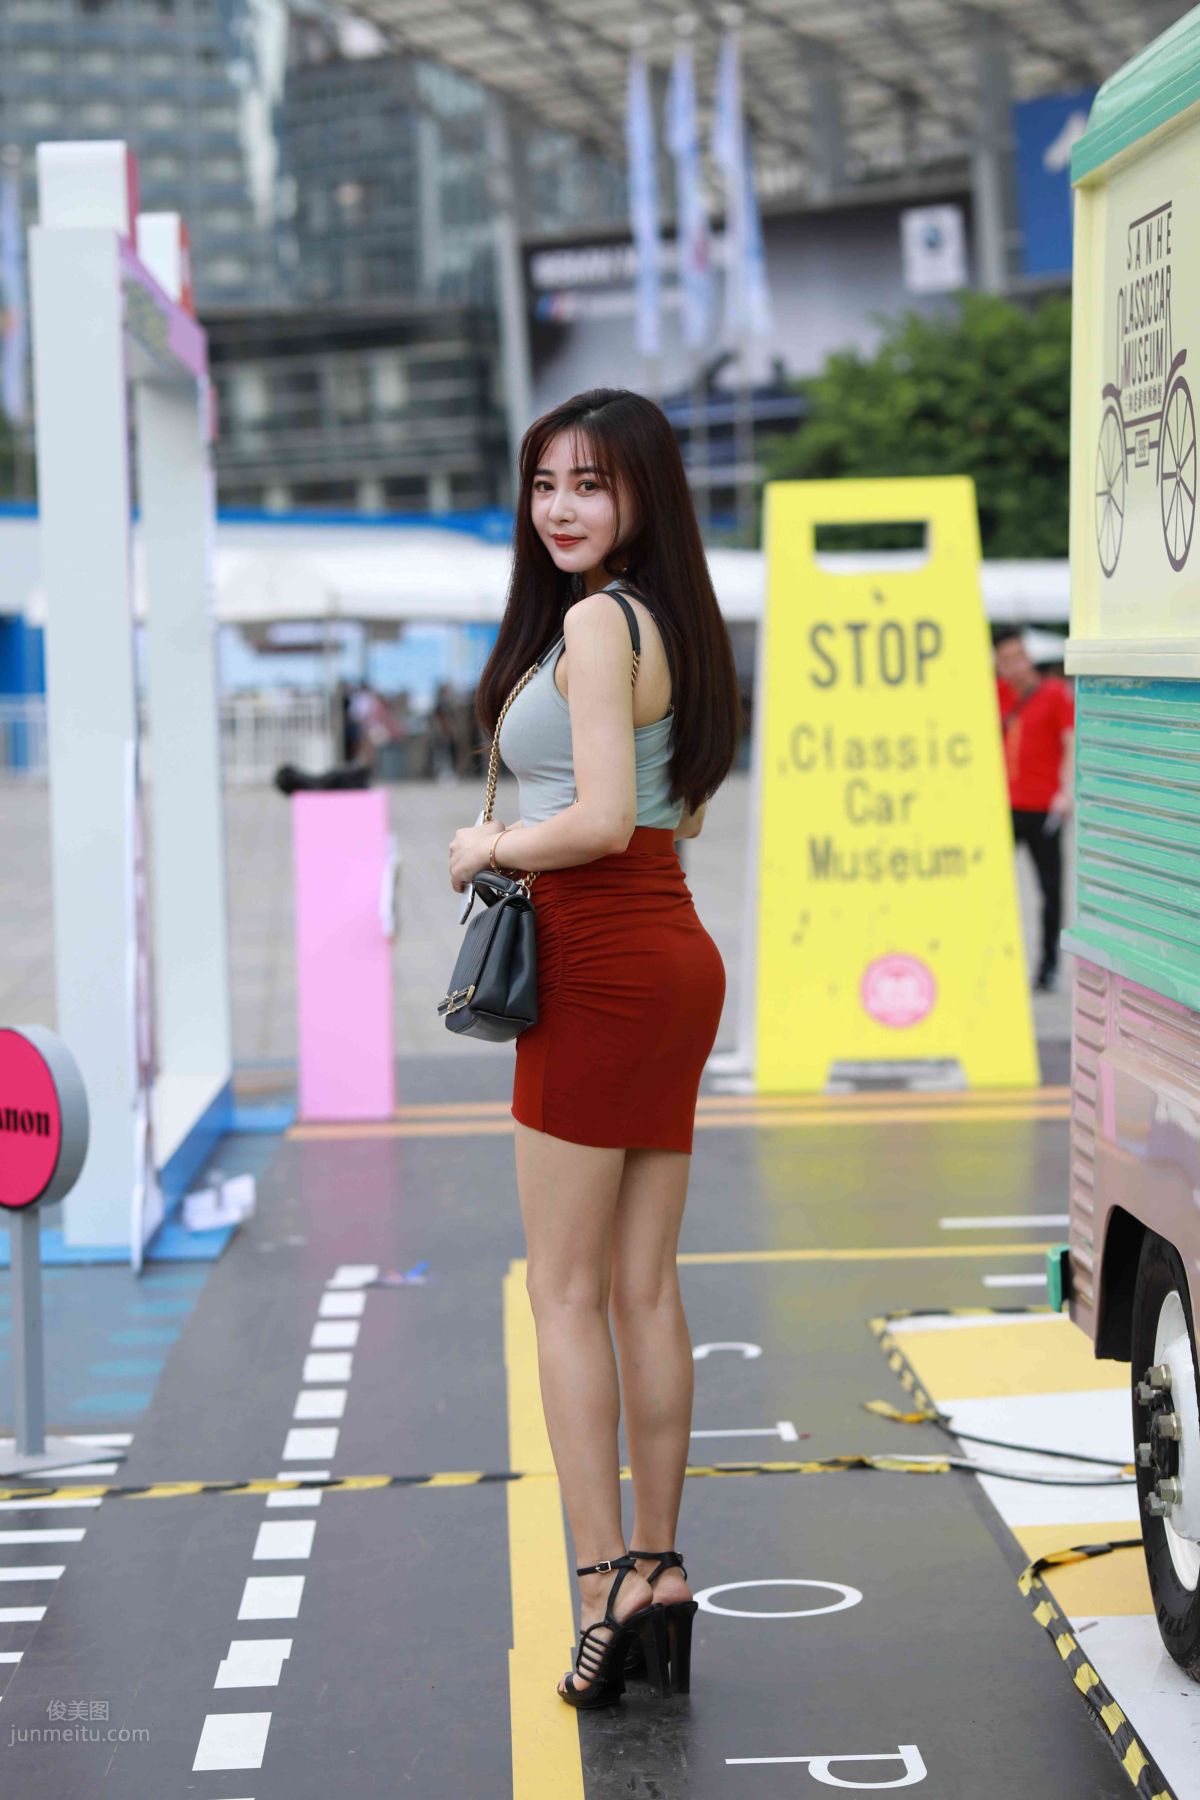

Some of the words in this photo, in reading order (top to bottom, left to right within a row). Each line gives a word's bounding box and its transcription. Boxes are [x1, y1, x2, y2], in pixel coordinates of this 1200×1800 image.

[1127, 211, 1172, 271] SANHE
[1122, 328, 1164, 388] MUSEUM
[808, 620, 943, 689] STOP
[790, 720, 973, 771] Classic
[844, 778, 917, 827] Car
[807, 834, 967, 882] Museum
[0, 1108, 50, 1137] non
